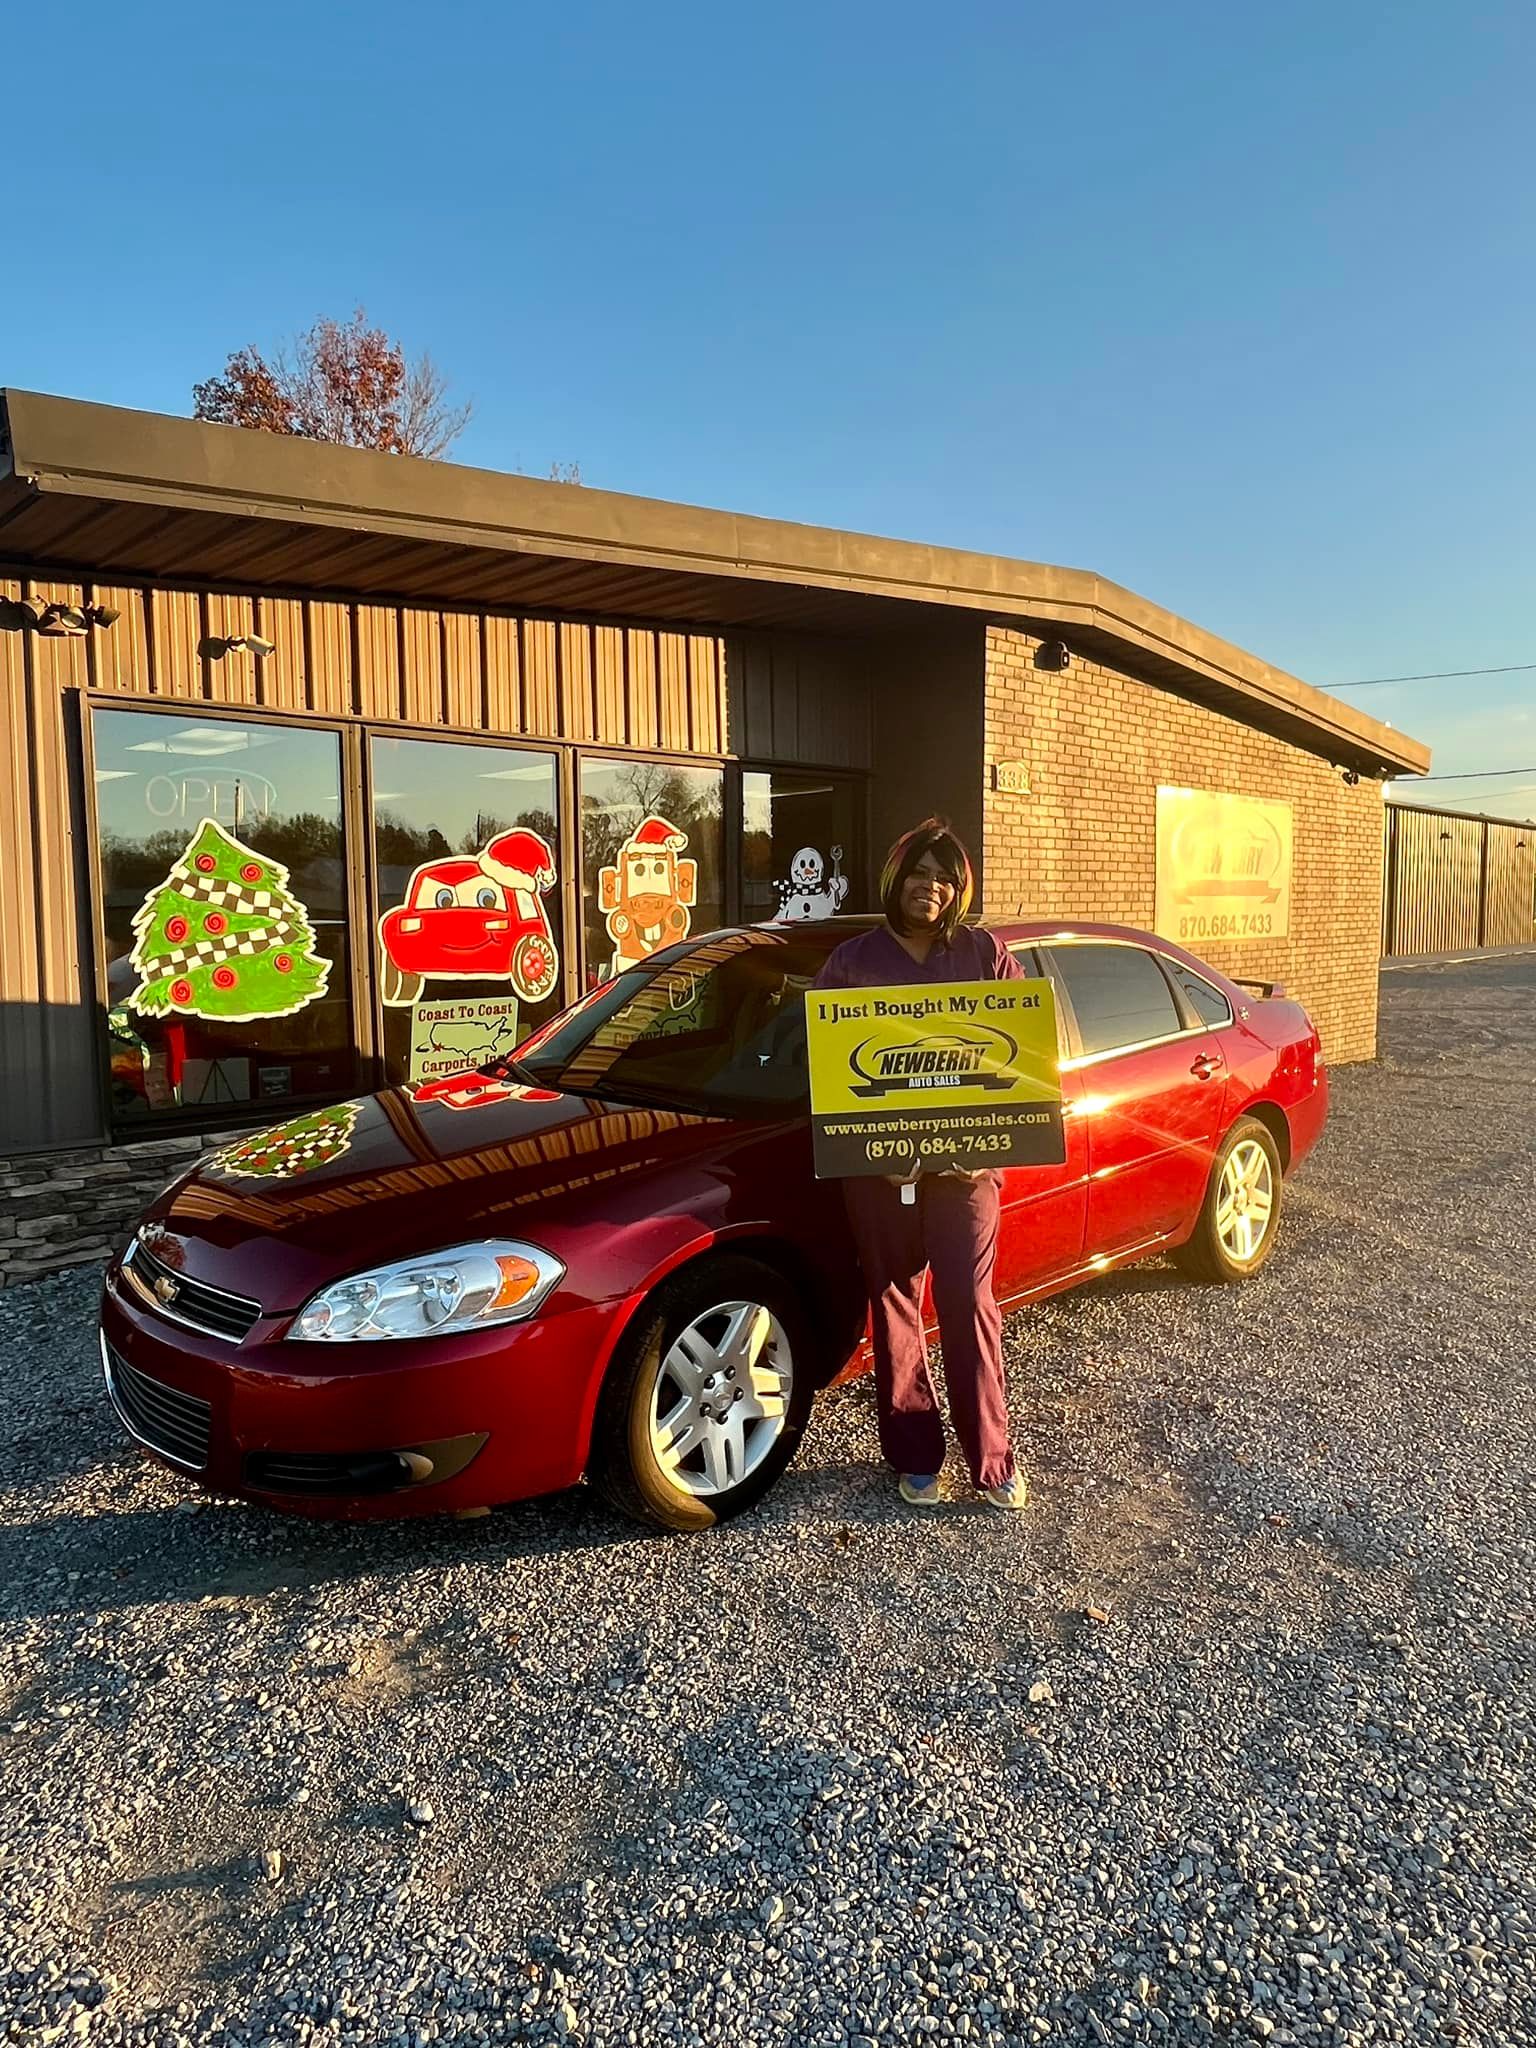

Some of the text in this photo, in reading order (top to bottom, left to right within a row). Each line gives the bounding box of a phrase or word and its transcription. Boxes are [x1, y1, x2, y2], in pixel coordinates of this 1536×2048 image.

[145, 775, 270, 821] OPEN
[1179, 914, 1272, 938] 870.684.7433
[418, 1003, 513, 1022] Coast To Coast
[819, 993, 1040, 1024] I Just Bought My Car at
[879, 1048, 986, 1076] NEWBERRY
[908, 1075, 961, 1088] AUTO SALES
[823, 1111, 1051, 1137] www.newberryautosales.com
[865, 1134, 1012, 1160] (870) 684-7433
